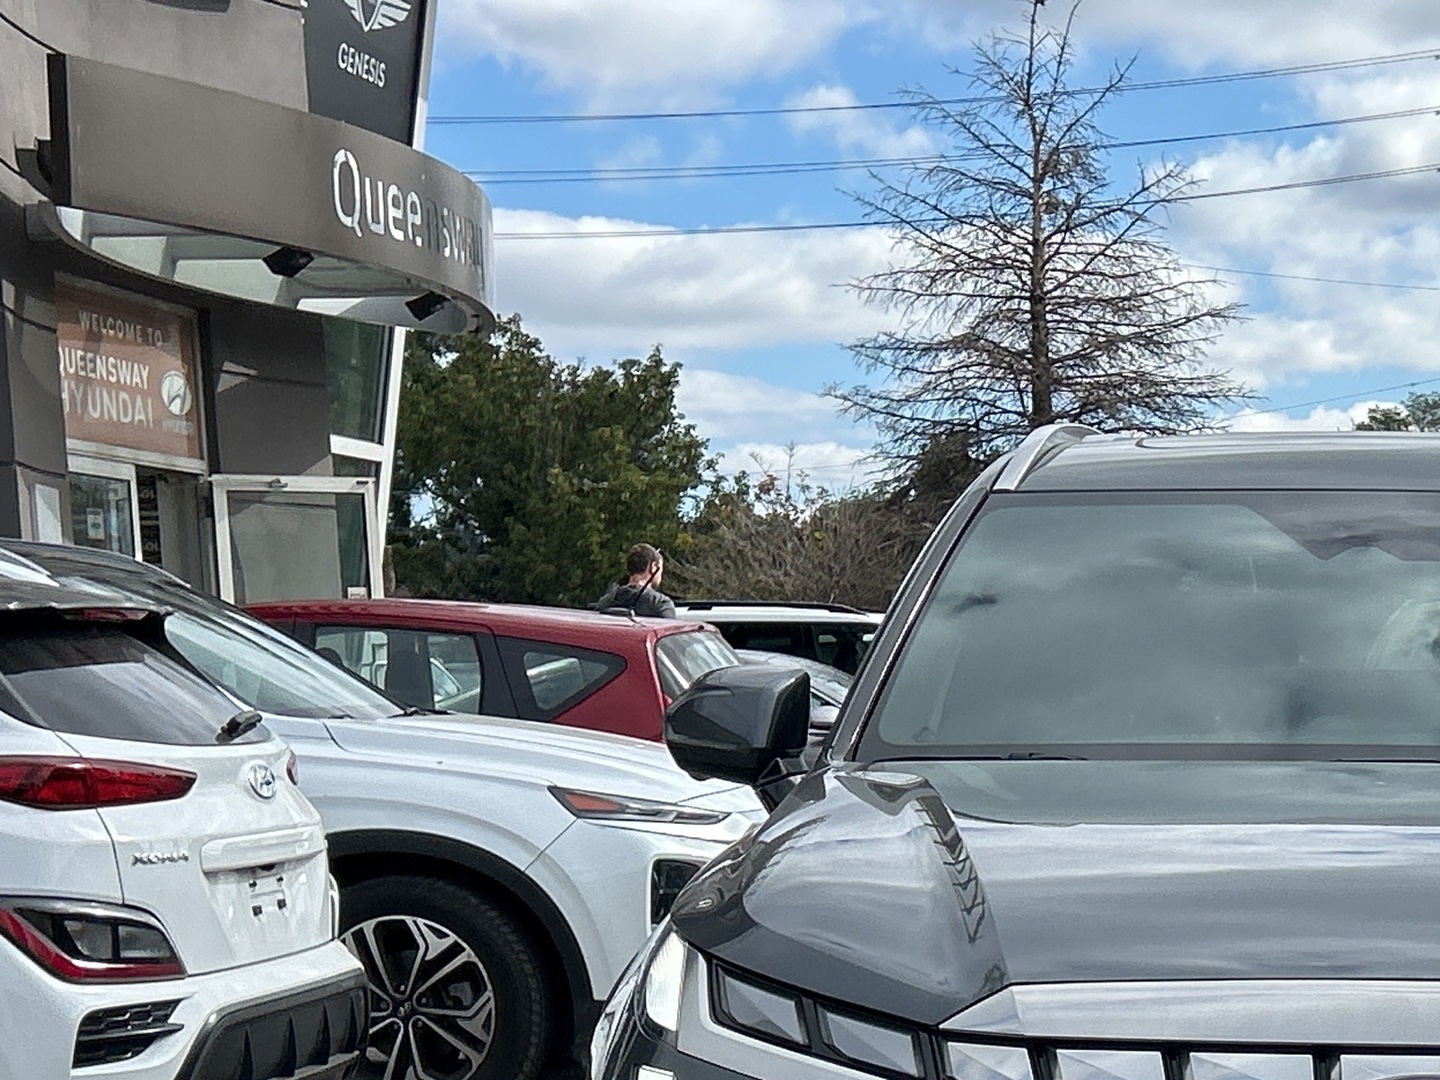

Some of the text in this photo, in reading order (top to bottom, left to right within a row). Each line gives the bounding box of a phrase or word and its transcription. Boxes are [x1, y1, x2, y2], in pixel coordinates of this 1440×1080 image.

[338, 42, 387, 88] GENESIS
[79, 309, 163, 347] WELCOME TO
